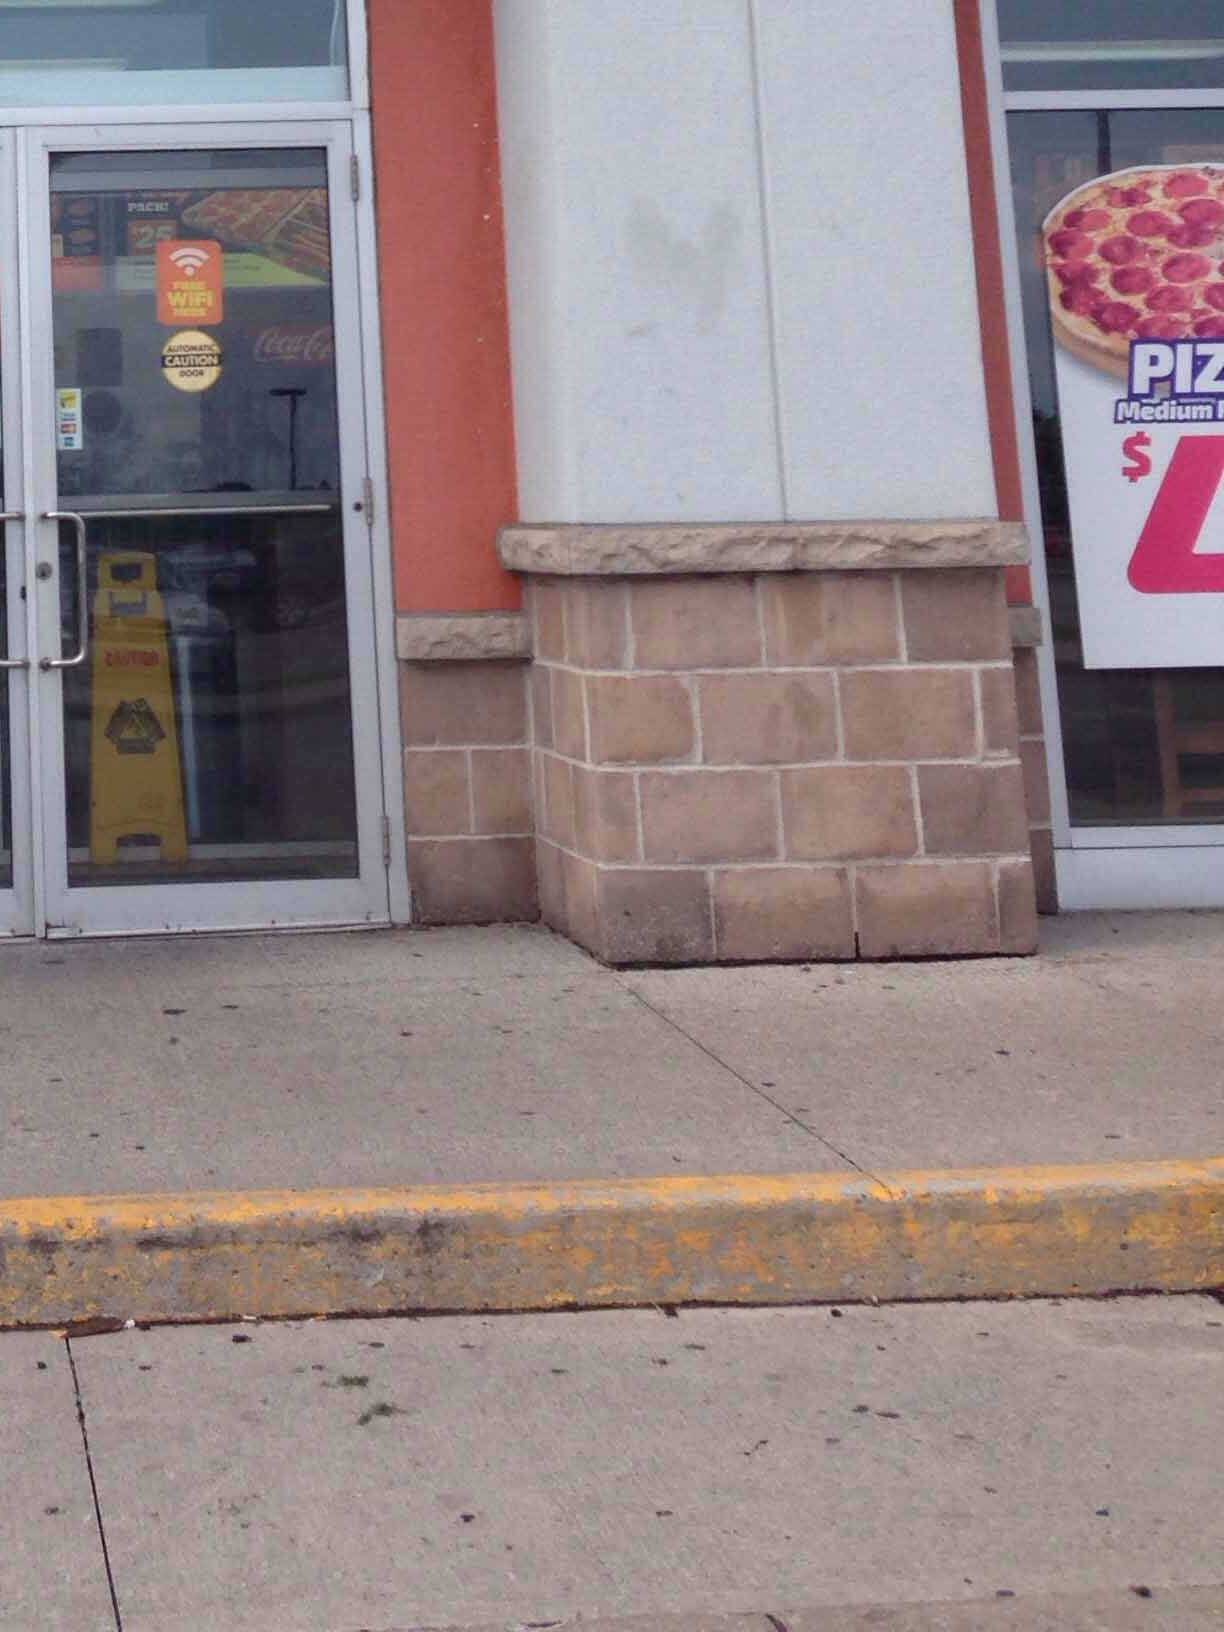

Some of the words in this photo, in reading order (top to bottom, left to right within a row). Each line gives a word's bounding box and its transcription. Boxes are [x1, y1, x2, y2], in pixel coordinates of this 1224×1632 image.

[167, 343, 217, 353] AUTOMATIC
[164, 354, 219, 367] CAUTION
[1116, 399, 1213, 422] Medium
